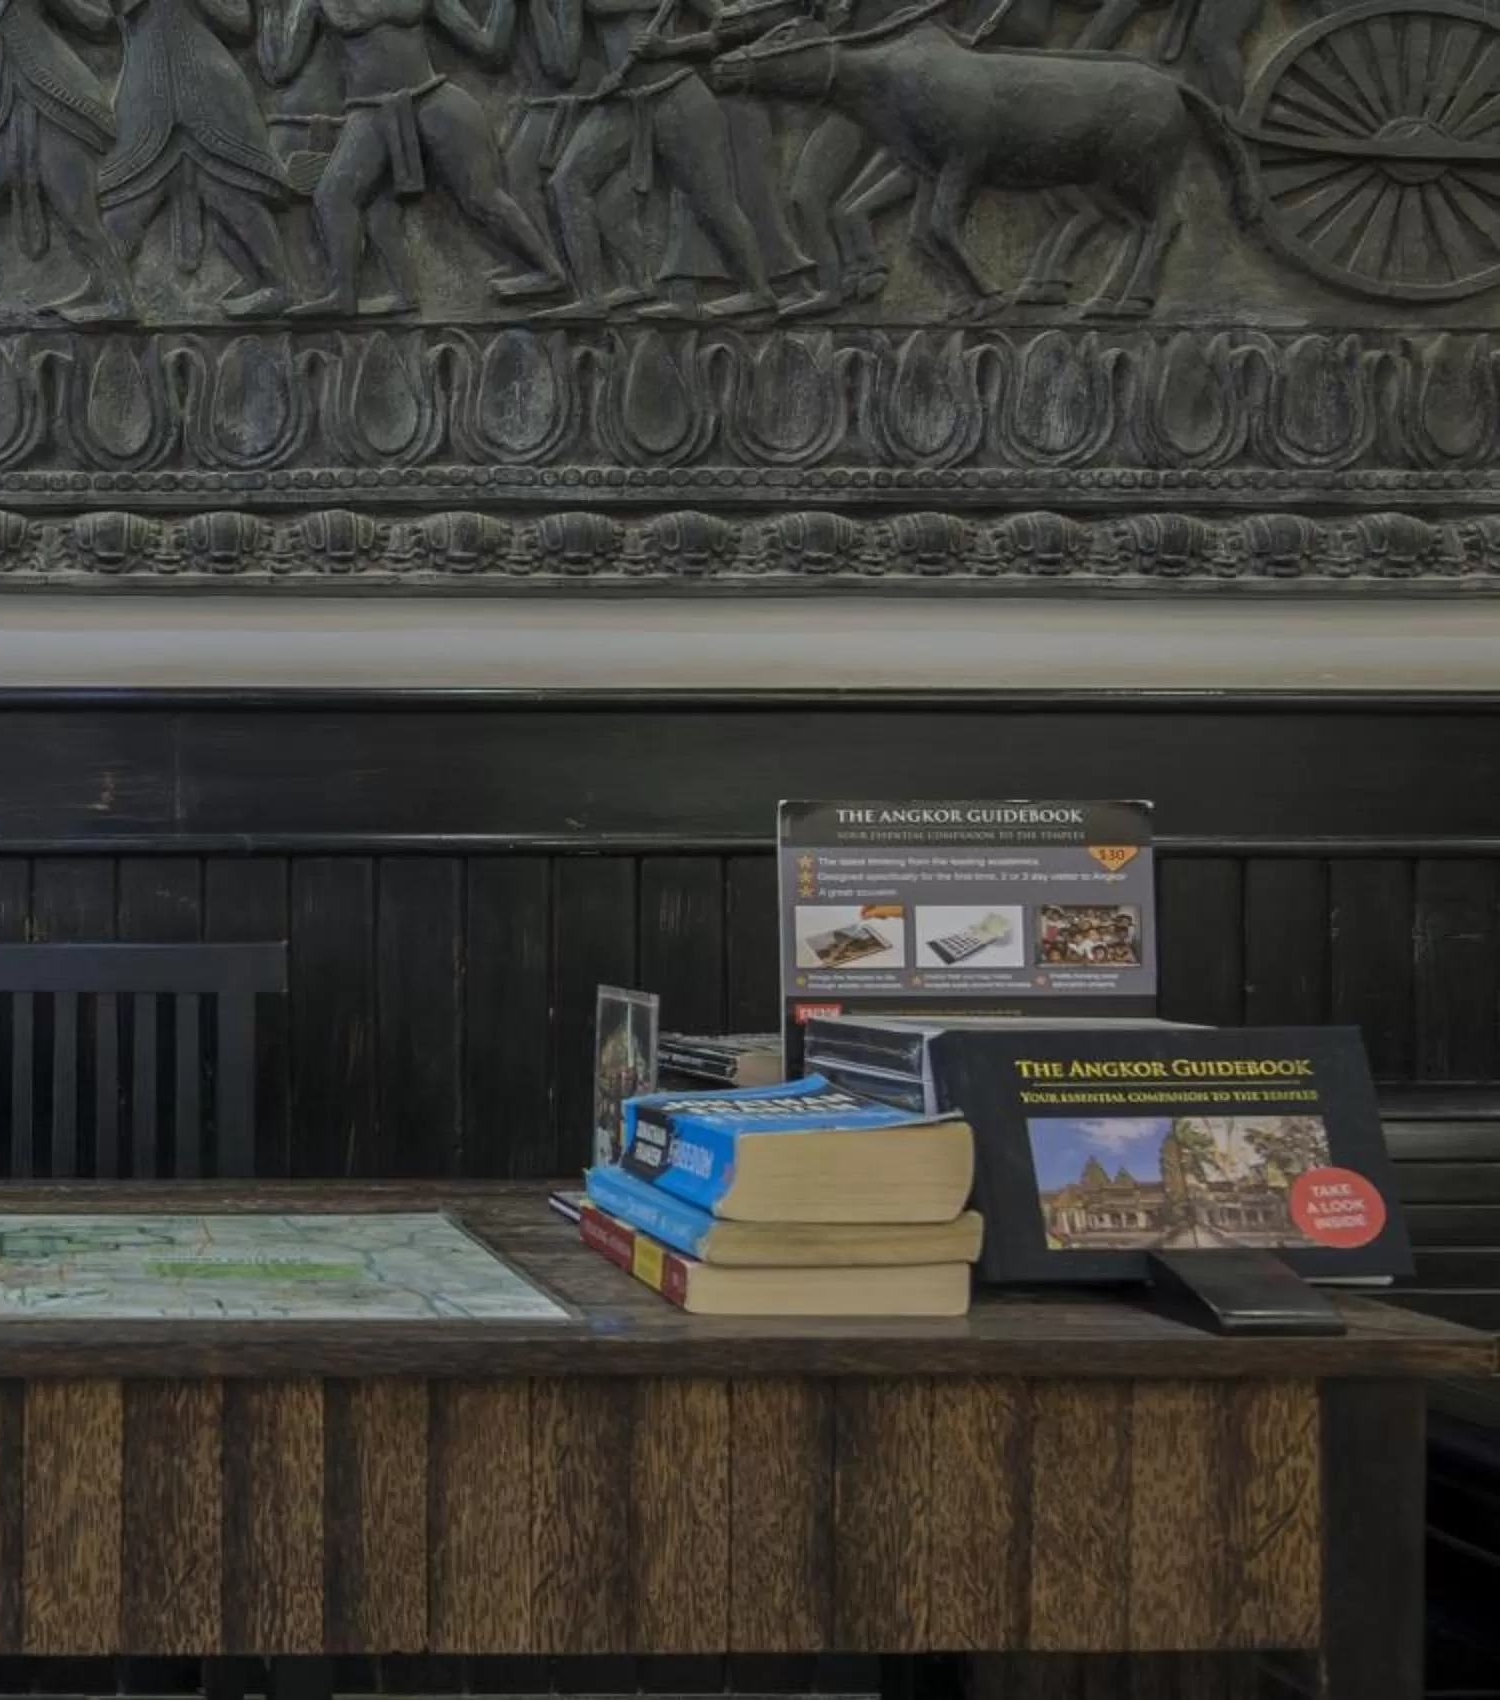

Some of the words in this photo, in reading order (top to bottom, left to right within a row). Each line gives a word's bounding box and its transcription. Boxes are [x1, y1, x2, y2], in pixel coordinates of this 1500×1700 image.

[835, 808, 876, 823] THE
[880, 808, 963, 823] ANGKOR
[967, 808, 1084, 823] GUIDEBOOK
[1014, 1059, 1065, 1078] THE
[1069, 1059, 1169, 1078] ANGKOR
[1171, 1058, 1315, 1077] GUIDEBOOK
[1020, 1091, 1058, 1103] YOUR
[1061, 1091, 1126, 1103] ESSENTIAL
[1127, 1091, 1208, 1103] COMPANION
[1210, 1091, 1230, 1102] TO
[1233, 1091, 1258, 1102] THE
[1260, 1090, 1318, 1102] TEMPLES
[1310, 1183, 1351, 1198] TAKE
[1320, 1199, 1365, 1213] LOOK
